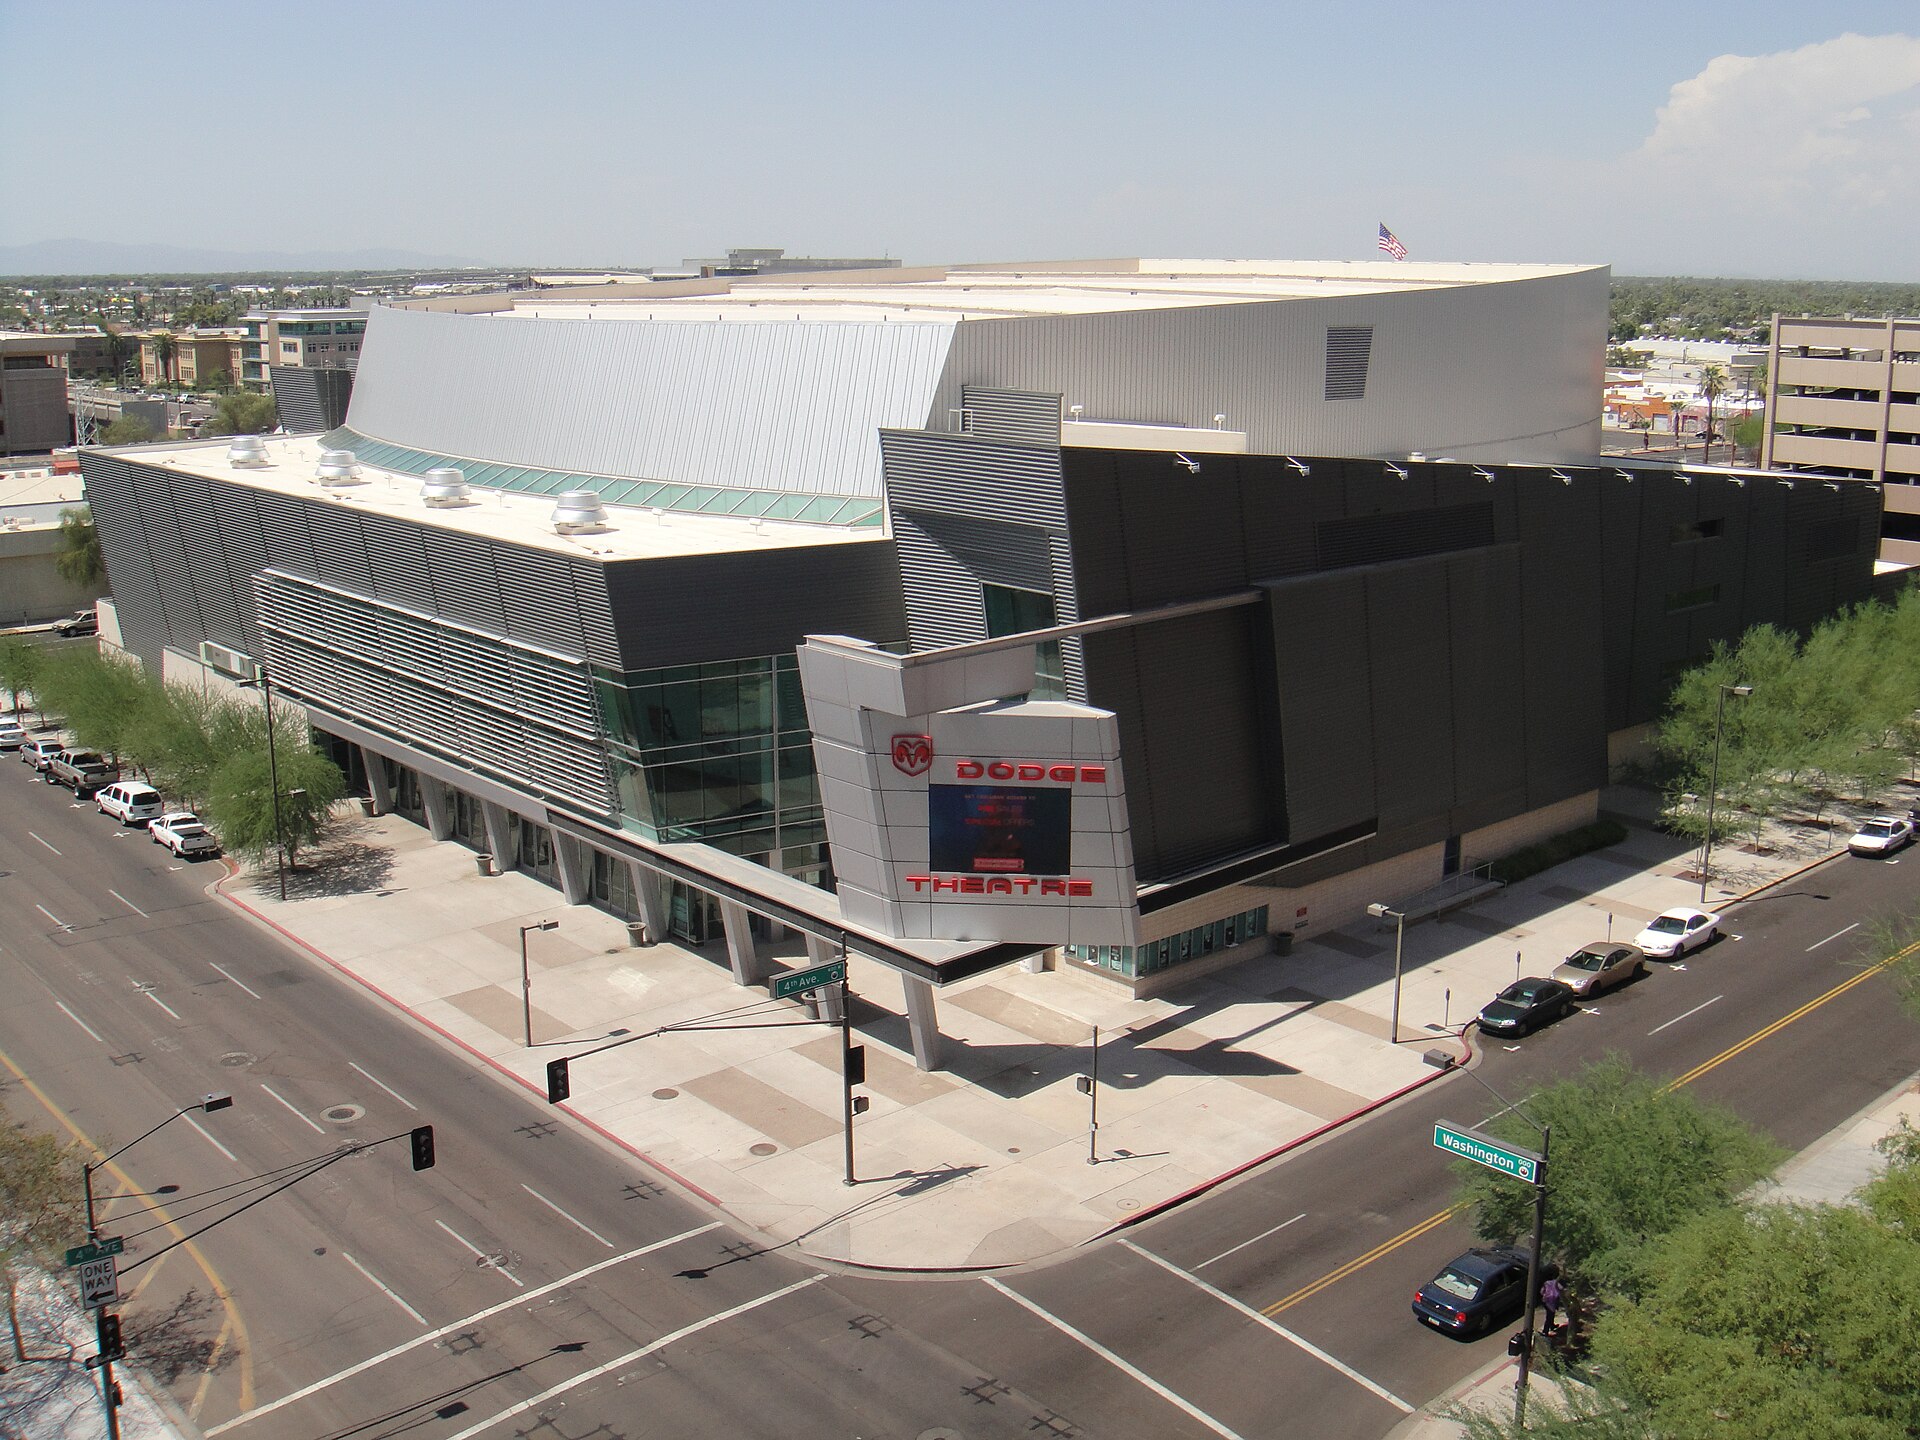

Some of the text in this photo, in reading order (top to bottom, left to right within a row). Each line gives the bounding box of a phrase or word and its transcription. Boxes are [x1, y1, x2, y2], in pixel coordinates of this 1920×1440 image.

[957, 762, 1106, 783] DODGE
[906, 876, 1093, 896] THEATRE
[783, 975, 820, 991] 4th Ave.
[1443, 1133, 1515, 1170] Washington
[84, 1262, 111, 1278] ONE
[85, 1273, 113, 1291] WAY
